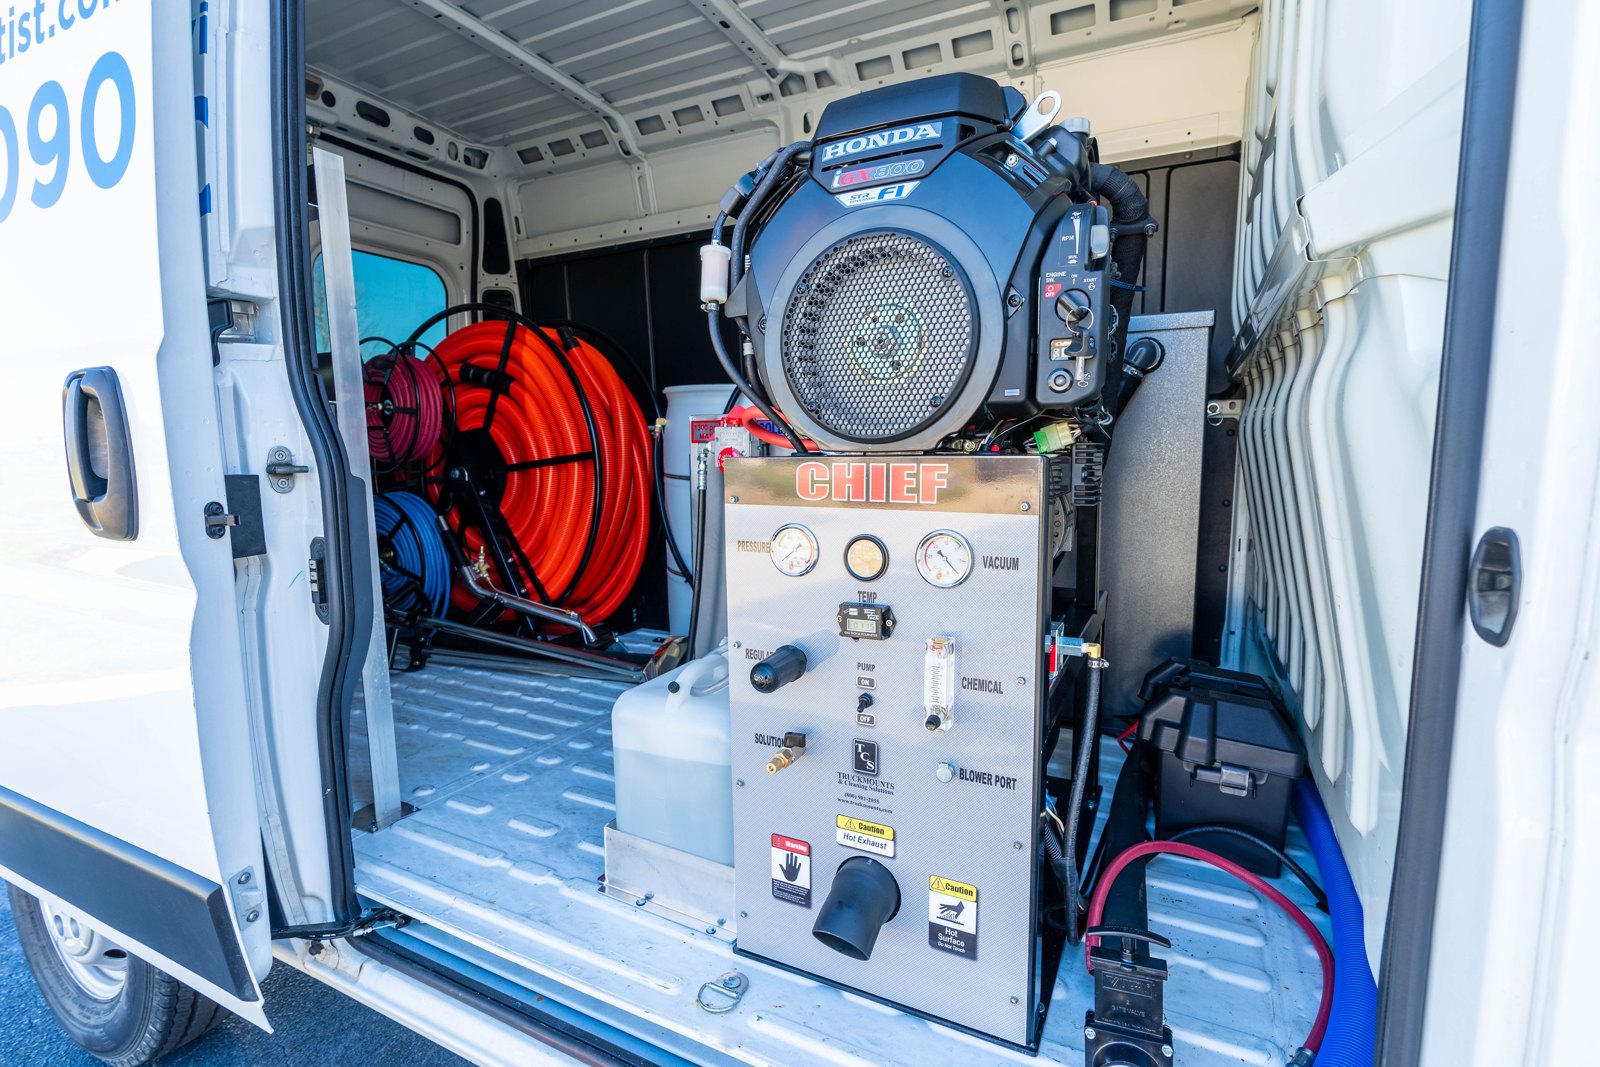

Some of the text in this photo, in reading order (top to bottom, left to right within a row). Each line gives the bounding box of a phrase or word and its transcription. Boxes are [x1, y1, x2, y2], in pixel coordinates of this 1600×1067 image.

[823, 124, 940, 161] HONDA
[850, 193, 870, 201] STR
[877, 185, 905, 200] FI
[796, 462, 949, 504] CHIEF
[737, 540, 770, 553] PRESSURE
[982, 555, 1019, 571] VACUUM
[858, 590, 877, 604] TEMP
[857, 662, 876, 672] PUMP
[961, 676, 1004, 695] CHEMICAL
[859, 715, 871, 723] OFF
[837, 772, 895, 790] TRUCKMOUNTS
[959, 768, 1017, 791] BLOWER PORT
[844, 780, 868, 791] Cleaning
[868, 786, 895, 796] Solutions
[858, 822, 885, 836] Caution
[785, 840, 808, 853] Warning
[843, 832, 887, 850] Hot Exhaust
[945, 883, 974, 897] Caution
[945, 927, 958, 938] Hot
[937, 933, 965, 948] Surface
[952, 945, 966, 954] Touch
